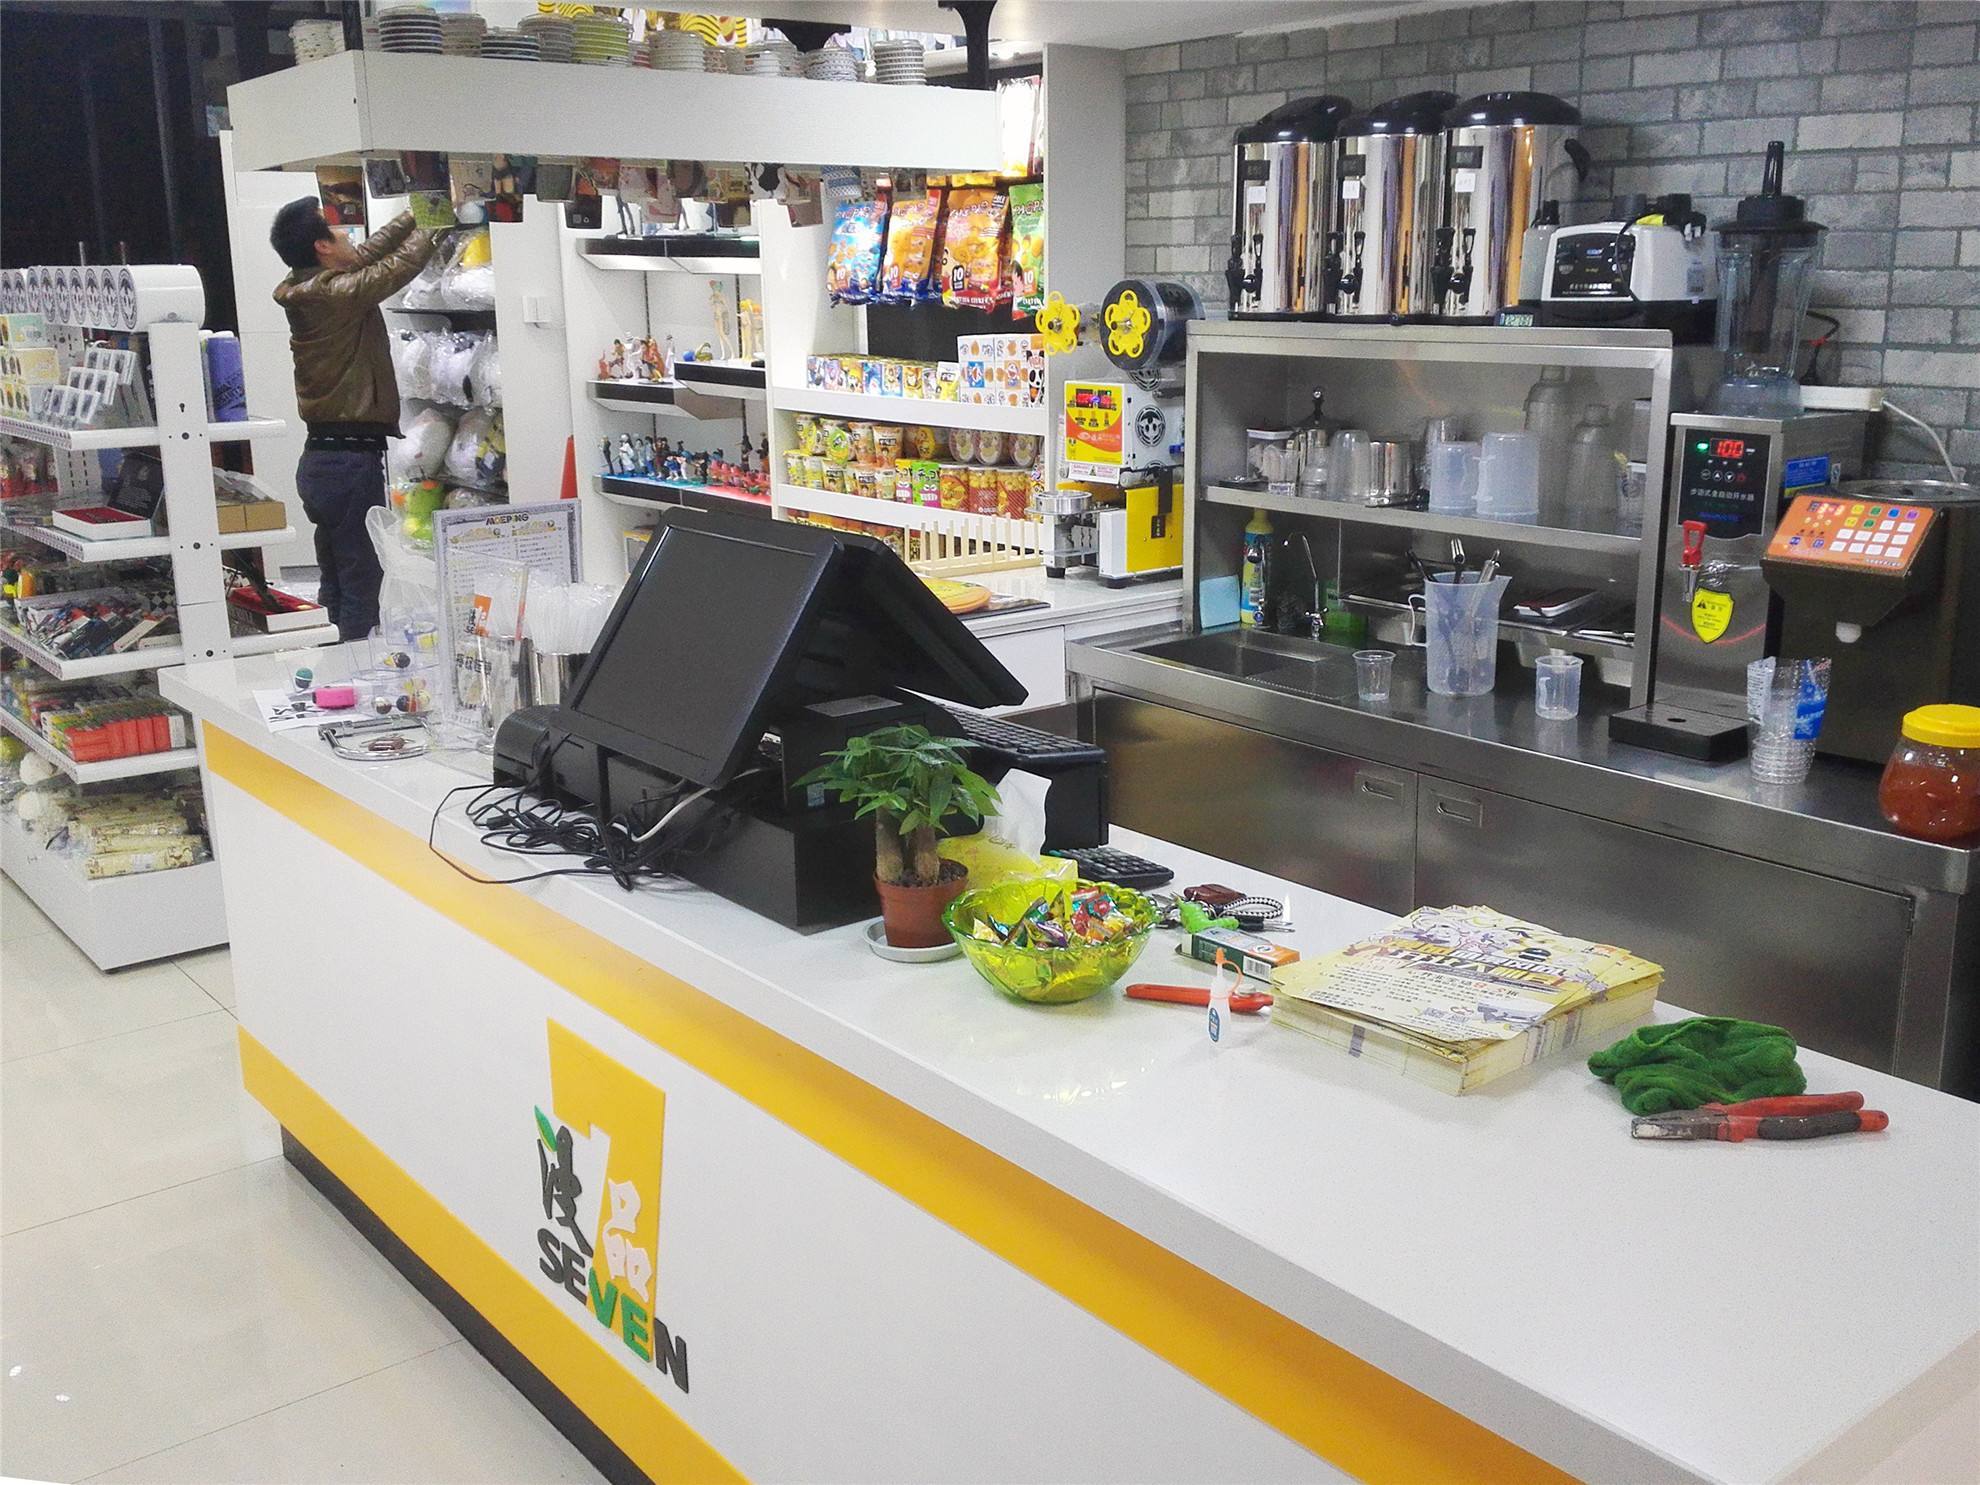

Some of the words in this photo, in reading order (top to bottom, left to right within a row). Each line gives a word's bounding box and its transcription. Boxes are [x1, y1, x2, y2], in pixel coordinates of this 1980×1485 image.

[953, 267, 965, 282] 10
[1717, 440, 1744, 458] 100
[537, 1227, 689, 1394] SEVEN
